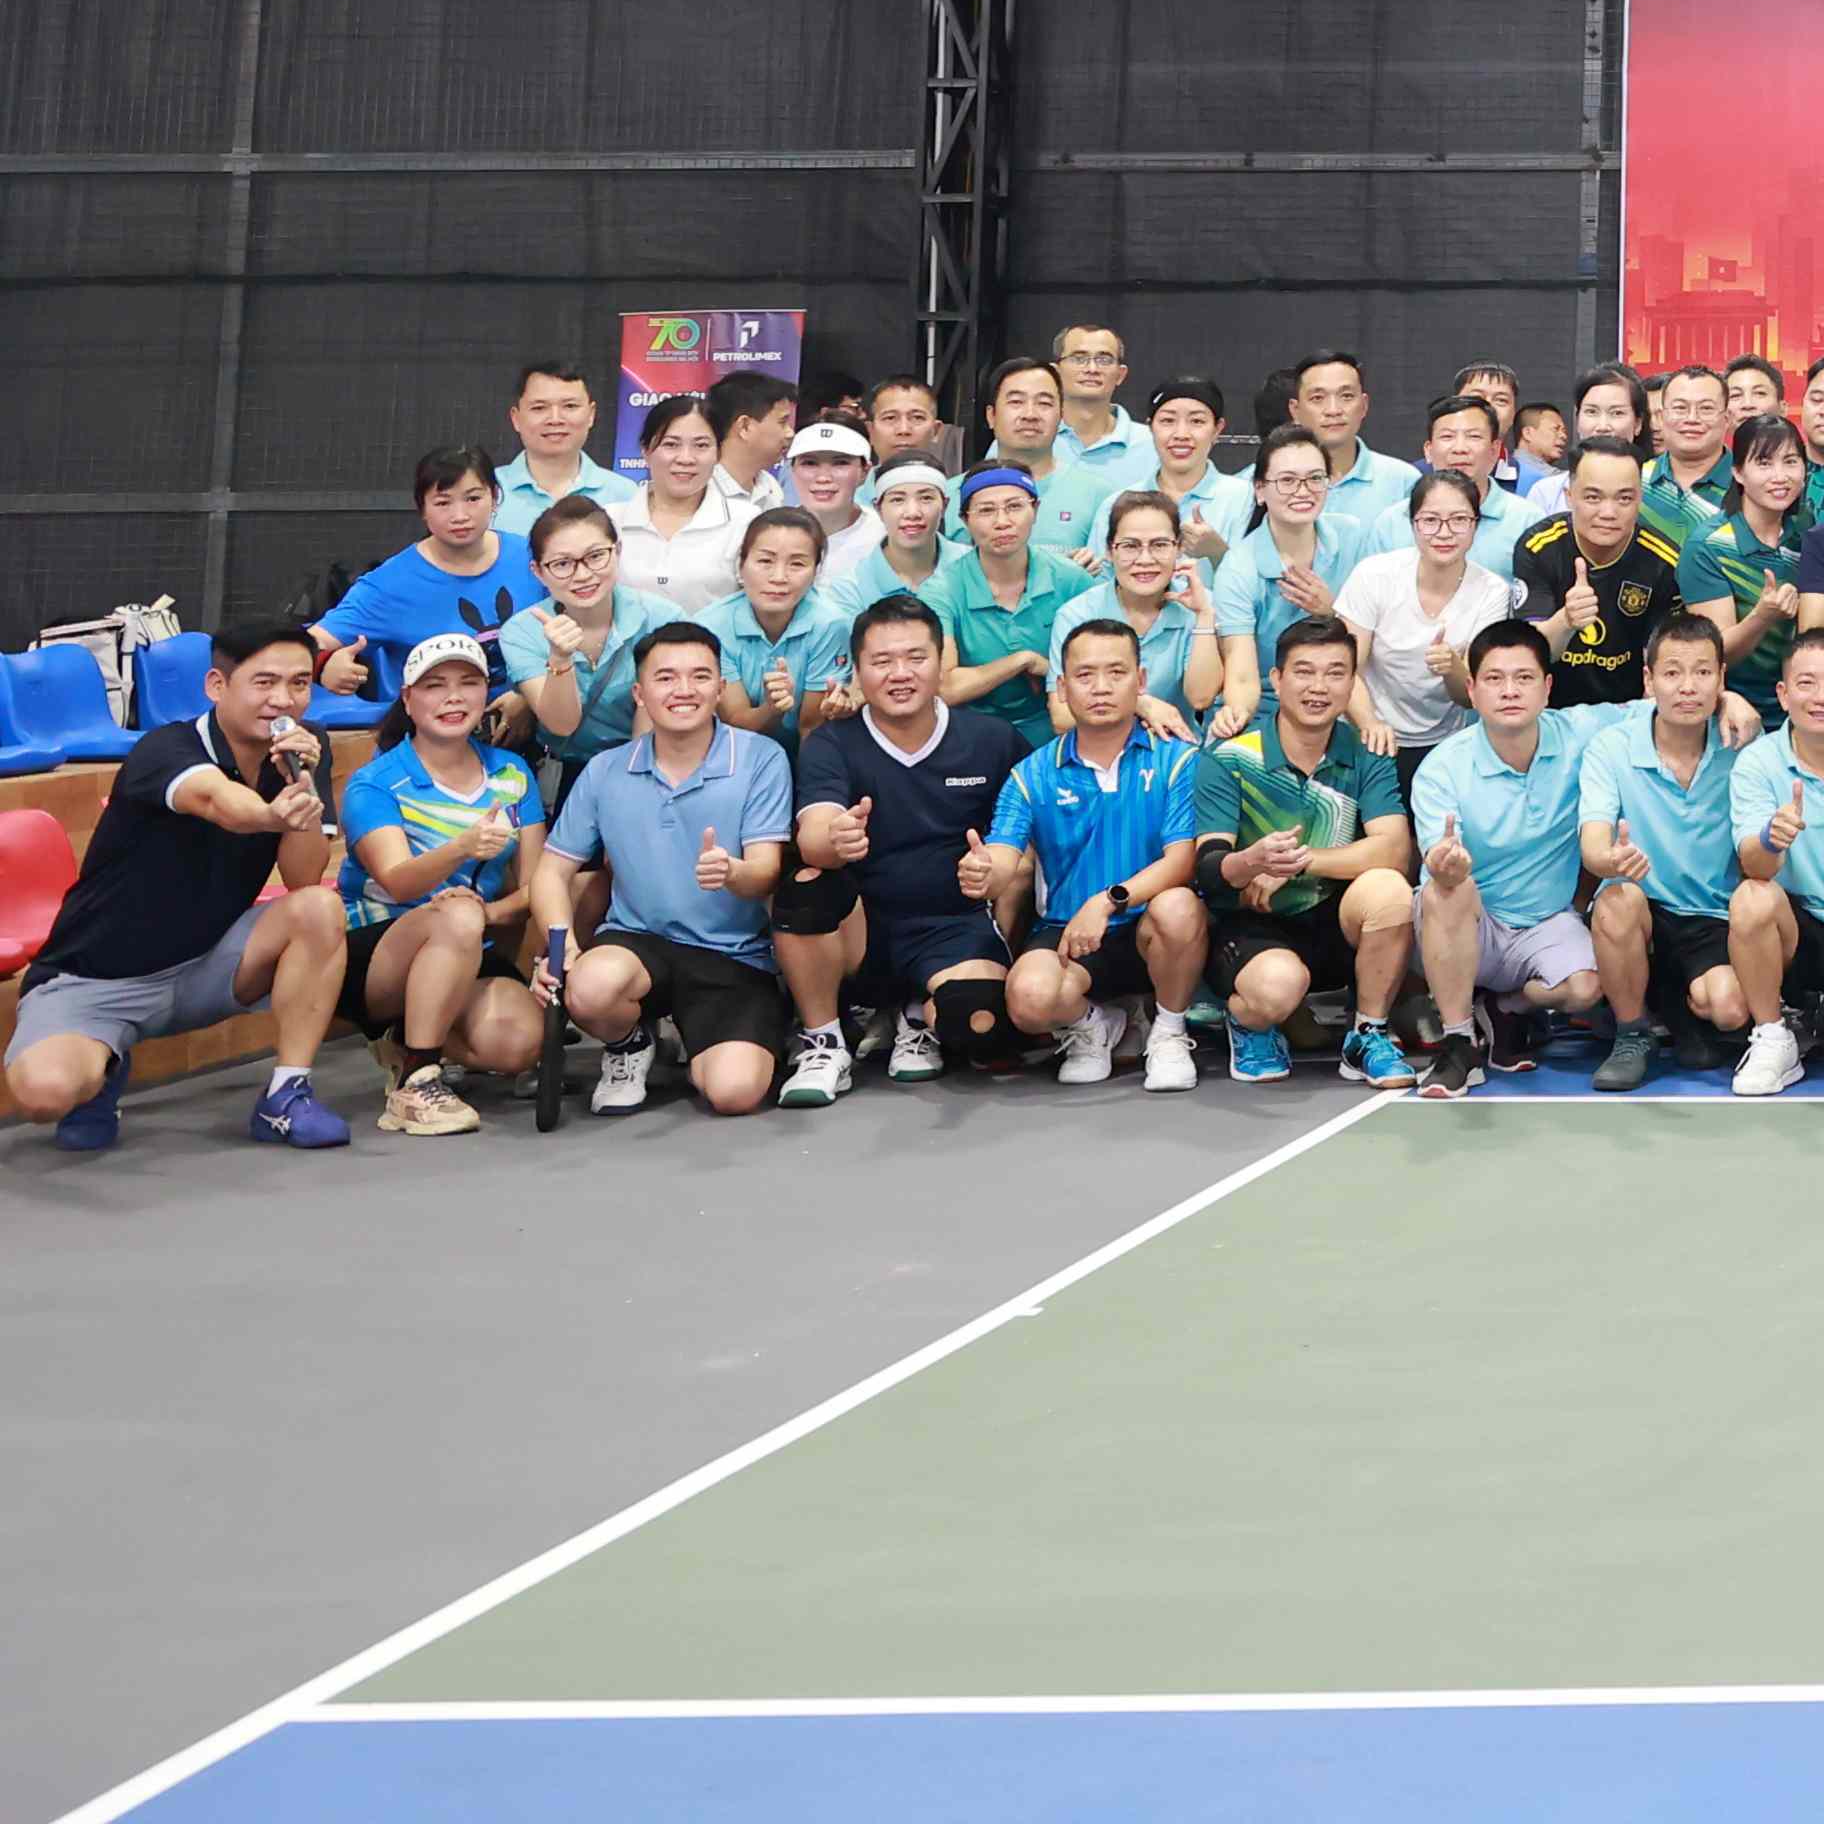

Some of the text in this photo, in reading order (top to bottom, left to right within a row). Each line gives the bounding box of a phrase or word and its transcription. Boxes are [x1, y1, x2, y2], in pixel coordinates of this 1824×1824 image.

[648, 318, 701, 350] 70
[713, 351, 782, 362] PETROLIMEX
[1561, 649, 1632, 671] apdragon
